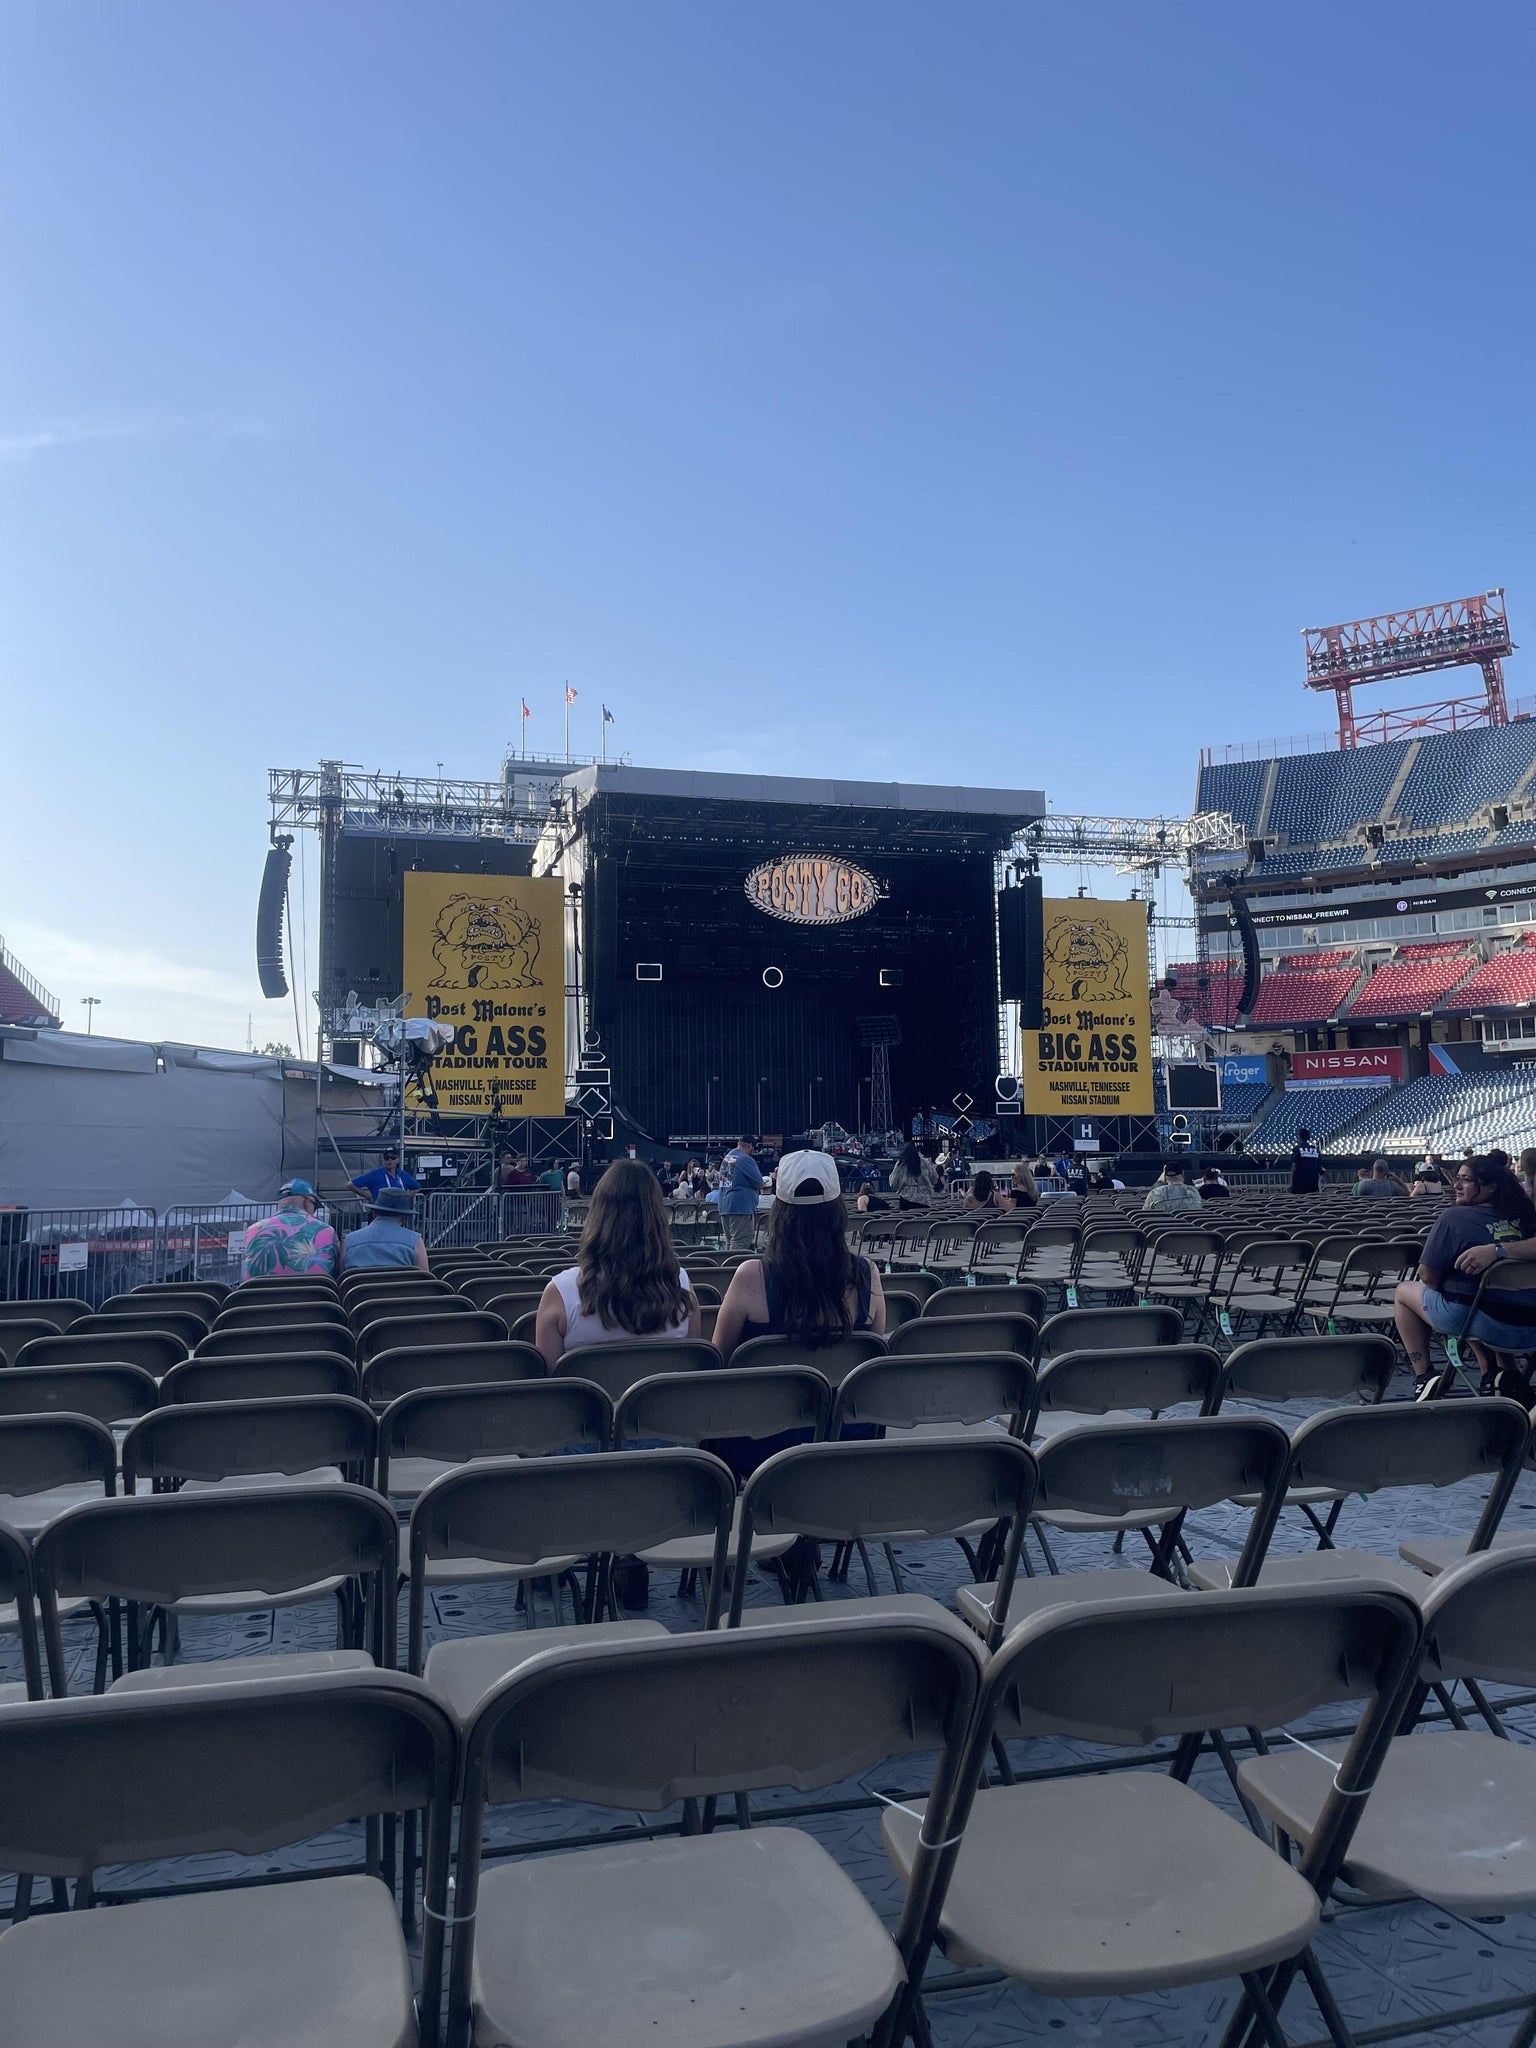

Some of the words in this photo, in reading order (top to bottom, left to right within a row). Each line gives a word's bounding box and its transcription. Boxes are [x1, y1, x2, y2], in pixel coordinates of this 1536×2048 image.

[757, 861, 829, 916] POSTY
[1413, 898, 1437, 906] NISSAN
[1286, 908, 1349, 921] NISSAN_FREEWIFI
[470, 954, 506, 963] POSTY
[1073, 970, 1102, 978] POSTY
[425, 995, 466, 1018] Post
[472, 999, 547, 1023] Malone's
[1076, 1010, 1135, 1031] Malone's
[486, 1025, 547, 1056] ASS
[1038, 1033, 1082, 1061] BIG
[1088, 1034, 1137, 1062] ASS
[503, 1057, 547, 1069] TOUR
[1038, 1061, 1099, 1072] STADIUM
[1103, 1062, 1138, 1073] TOUR
[1306, 1055, 1388, 1069] NISSAN
[1220, 1061, 1260, 1083] Kroger
[435, 1079, 485, 1092] NASHVILLE,
[1049, 1081, 1090, 1093] NASHVILLE,
[1090, 1081, 1130, 1092] TENNESSEE
[449, 1094, 482, 1106] NISSAN
[1061, 1095, 1087, 1105] NISSAN
[1089, 1095, 1120, 1105] STADIUM
[1081, 1124, 1092, 1138] H
[445, 1158, 453, 1167] C
